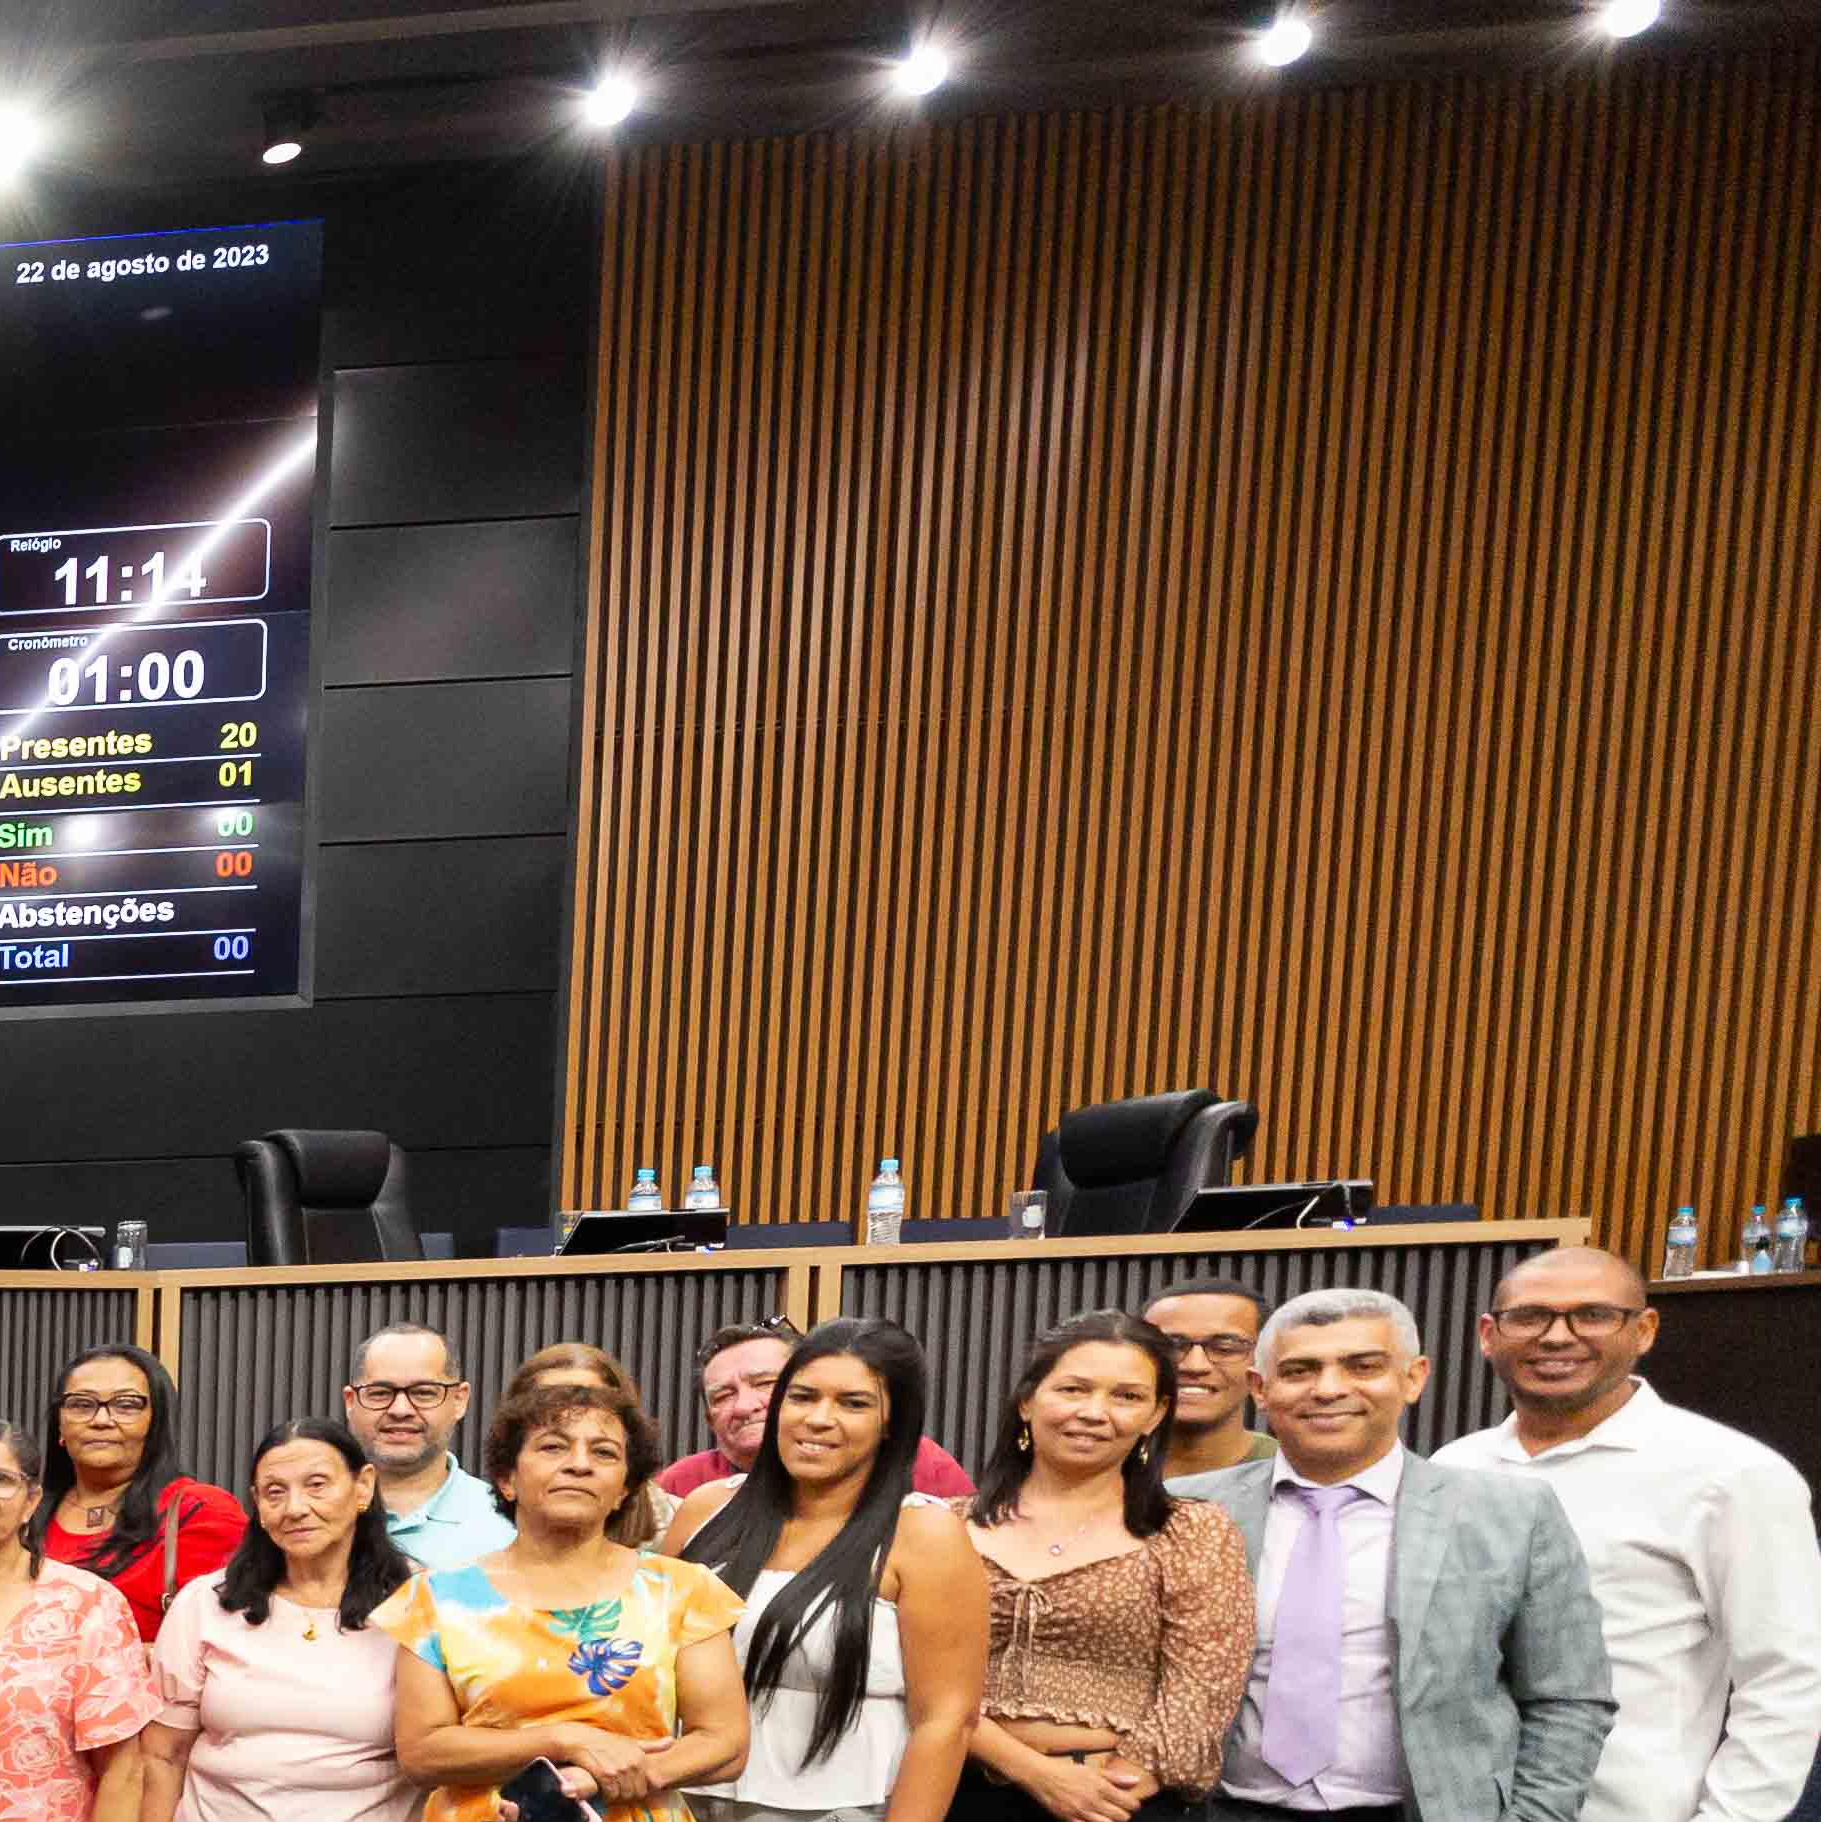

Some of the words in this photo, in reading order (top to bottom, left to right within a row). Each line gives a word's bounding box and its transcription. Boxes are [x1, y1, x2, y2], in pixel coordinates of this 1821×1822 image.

[16, 261, 45, 284] 22
[51, 260, 80, 281] de
[87, 253, 170, 282] agosto
[176, 249, 206, 271] de
[212, 244, 270, 269] 2023
[10, 537, 62, 552] Relógio
[55, 551, 207, 605] 11:14
[8, 635, 88, 651] Cronômetro
[48, 650, 205, 705] 01:00
[0, 730, 153, 761] Presentes
[219, 721, 258, 749] 20
[218, 761, 253, 787] 01
[216, 810, 253, 837] 00
[215, 851, 253, 878] 00
[213, 935, 249, 961] 00
